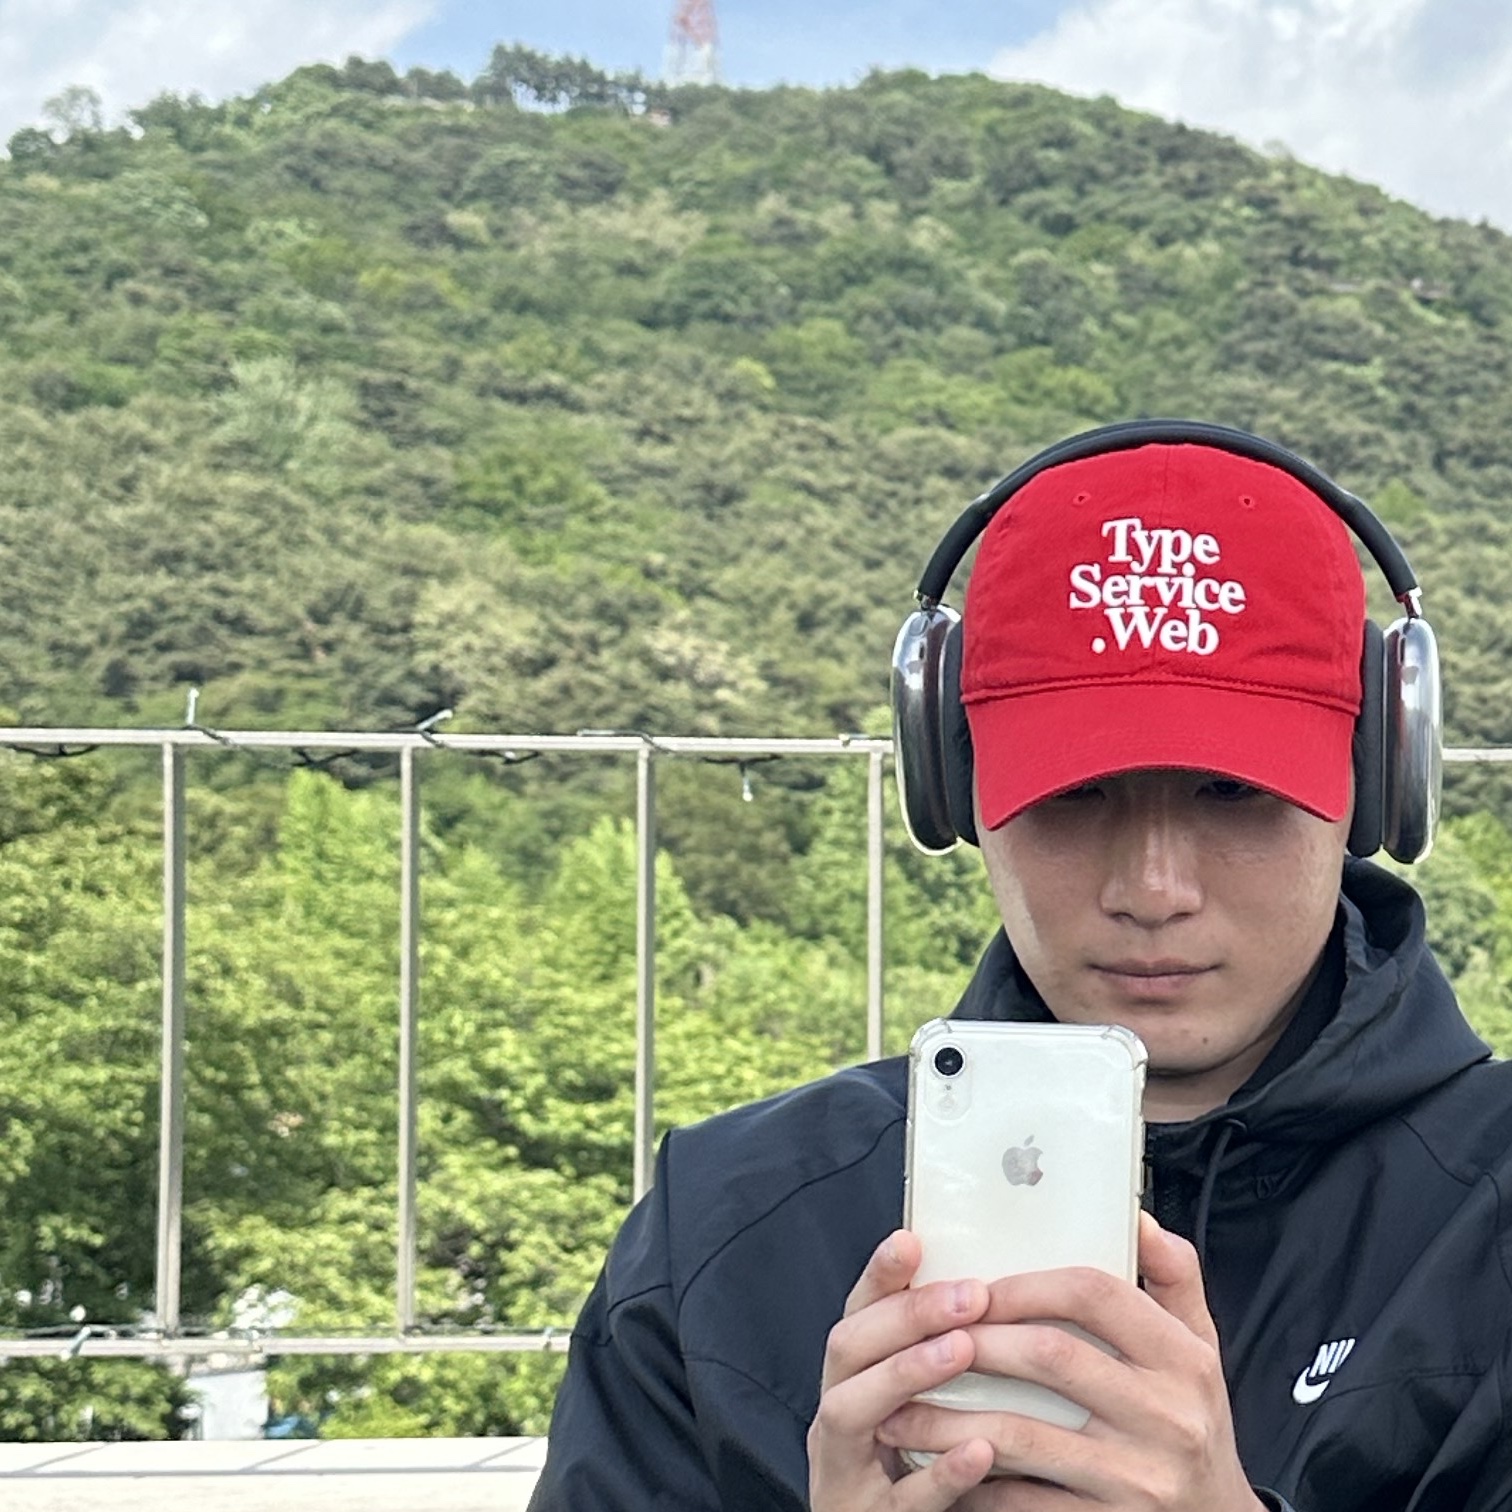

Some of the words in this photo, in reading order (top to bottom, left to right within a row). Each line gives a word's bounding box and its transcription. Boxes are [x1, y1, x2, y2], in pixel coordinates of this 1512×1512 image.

[1101, 517, 1220, 574] Type
[1069, 562, 1246, 614] Service
[1091, 606, 1219, 655] .Web
